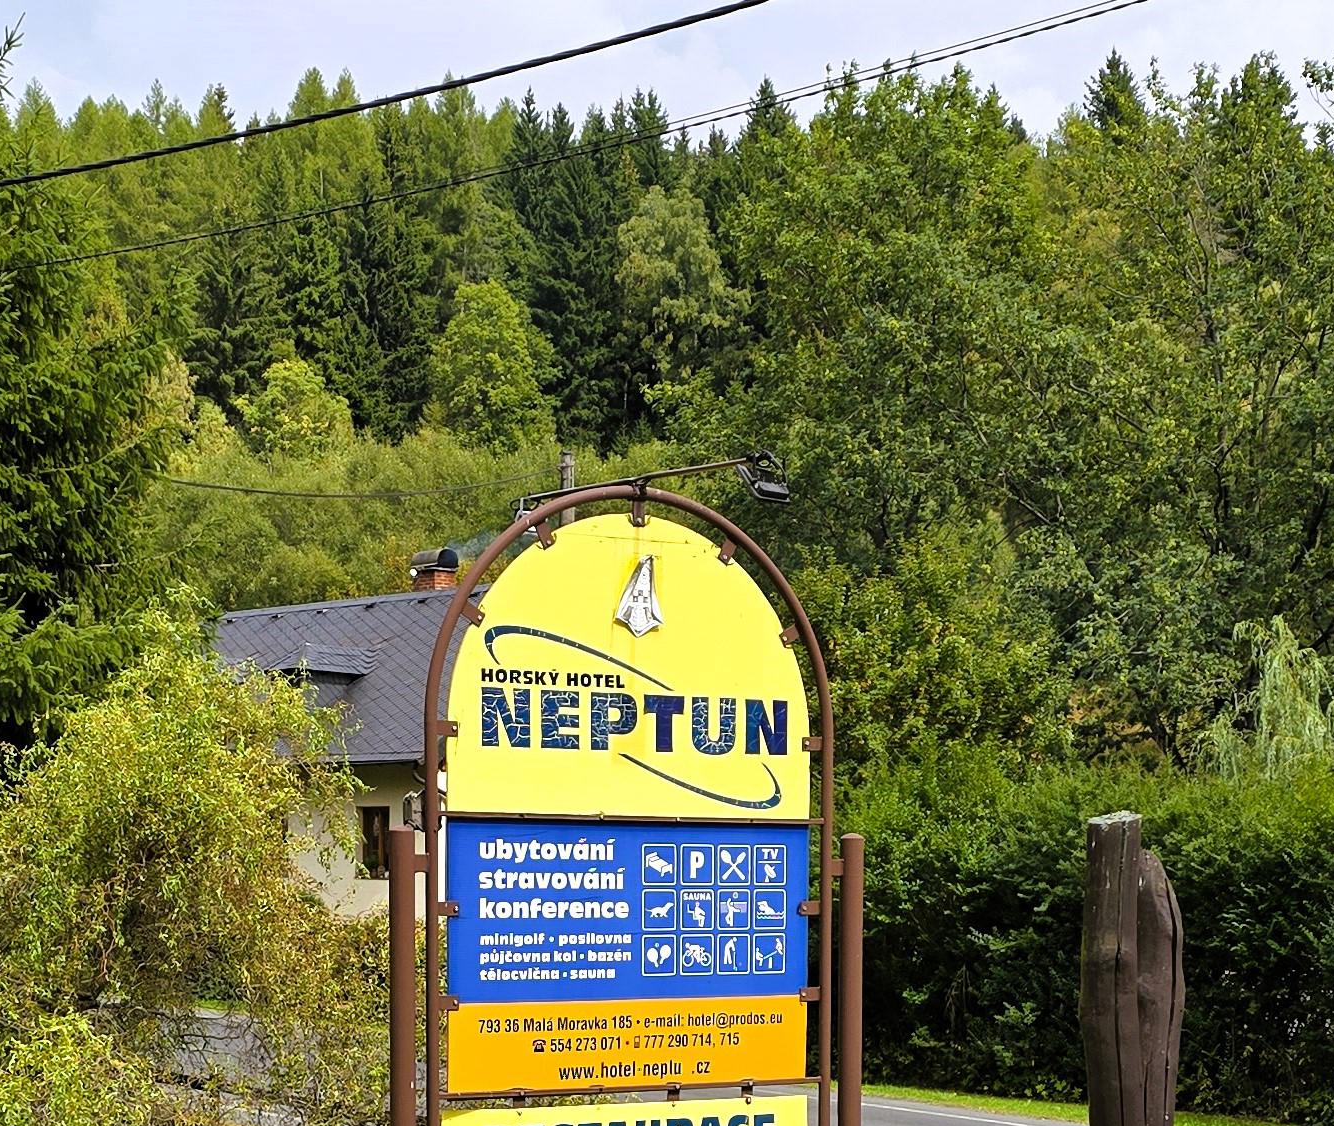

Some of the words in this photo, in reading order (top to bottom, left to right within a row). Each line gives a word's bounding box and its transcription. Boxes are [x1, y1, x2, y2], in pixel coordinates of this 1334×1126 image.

[481, 668, 559, 685] HORSKÝ
[567, 673, 625, 688] HOTEL
[481, 687, 788, 756] NEPTUN
[480, 838, 615, 863] ubytování
[762, 849, 778, 859] TV
[690, 851, 704, 878] P
[479, 868, 625, 889] stravování
[683, 892, 711, 901] SAUNA
[480, 898, 629, 918] konference
[480, 933, 544, 947] minigolf
[559, 933, 631, 946] posilovna
[480, 949, 550, 964] půjčovna
[554, 951, 576, 962] kol
[588, 949, 631, 961] bazén
[480, 967, 559, 980] tělocvična
[570, 969, 615, 979] sauna
[479, 1019, 500, 1033] 793
[505, 1019, 519, 1032] 36
[524, 1018, 552, 1032] Malá
[558, 1017, 607, 1030] Moravka
[612, 1016, 632, 1029] 185
[644, 1014, 683, 1028] e-mail:
[688, 1012, 782, 1028] hotel@prodos.eu
[551, 1039, 571, 1052] 554
[576, 1037, 596, 1051] 273
[601, 1037, 620, 1050] 071
[644, 1035, 664, 1048] 777
[668, 1034, 688, 1047] 290
[692, 1033, 716, 1048] 714,
[720, 1033, 739, 1045] 715
